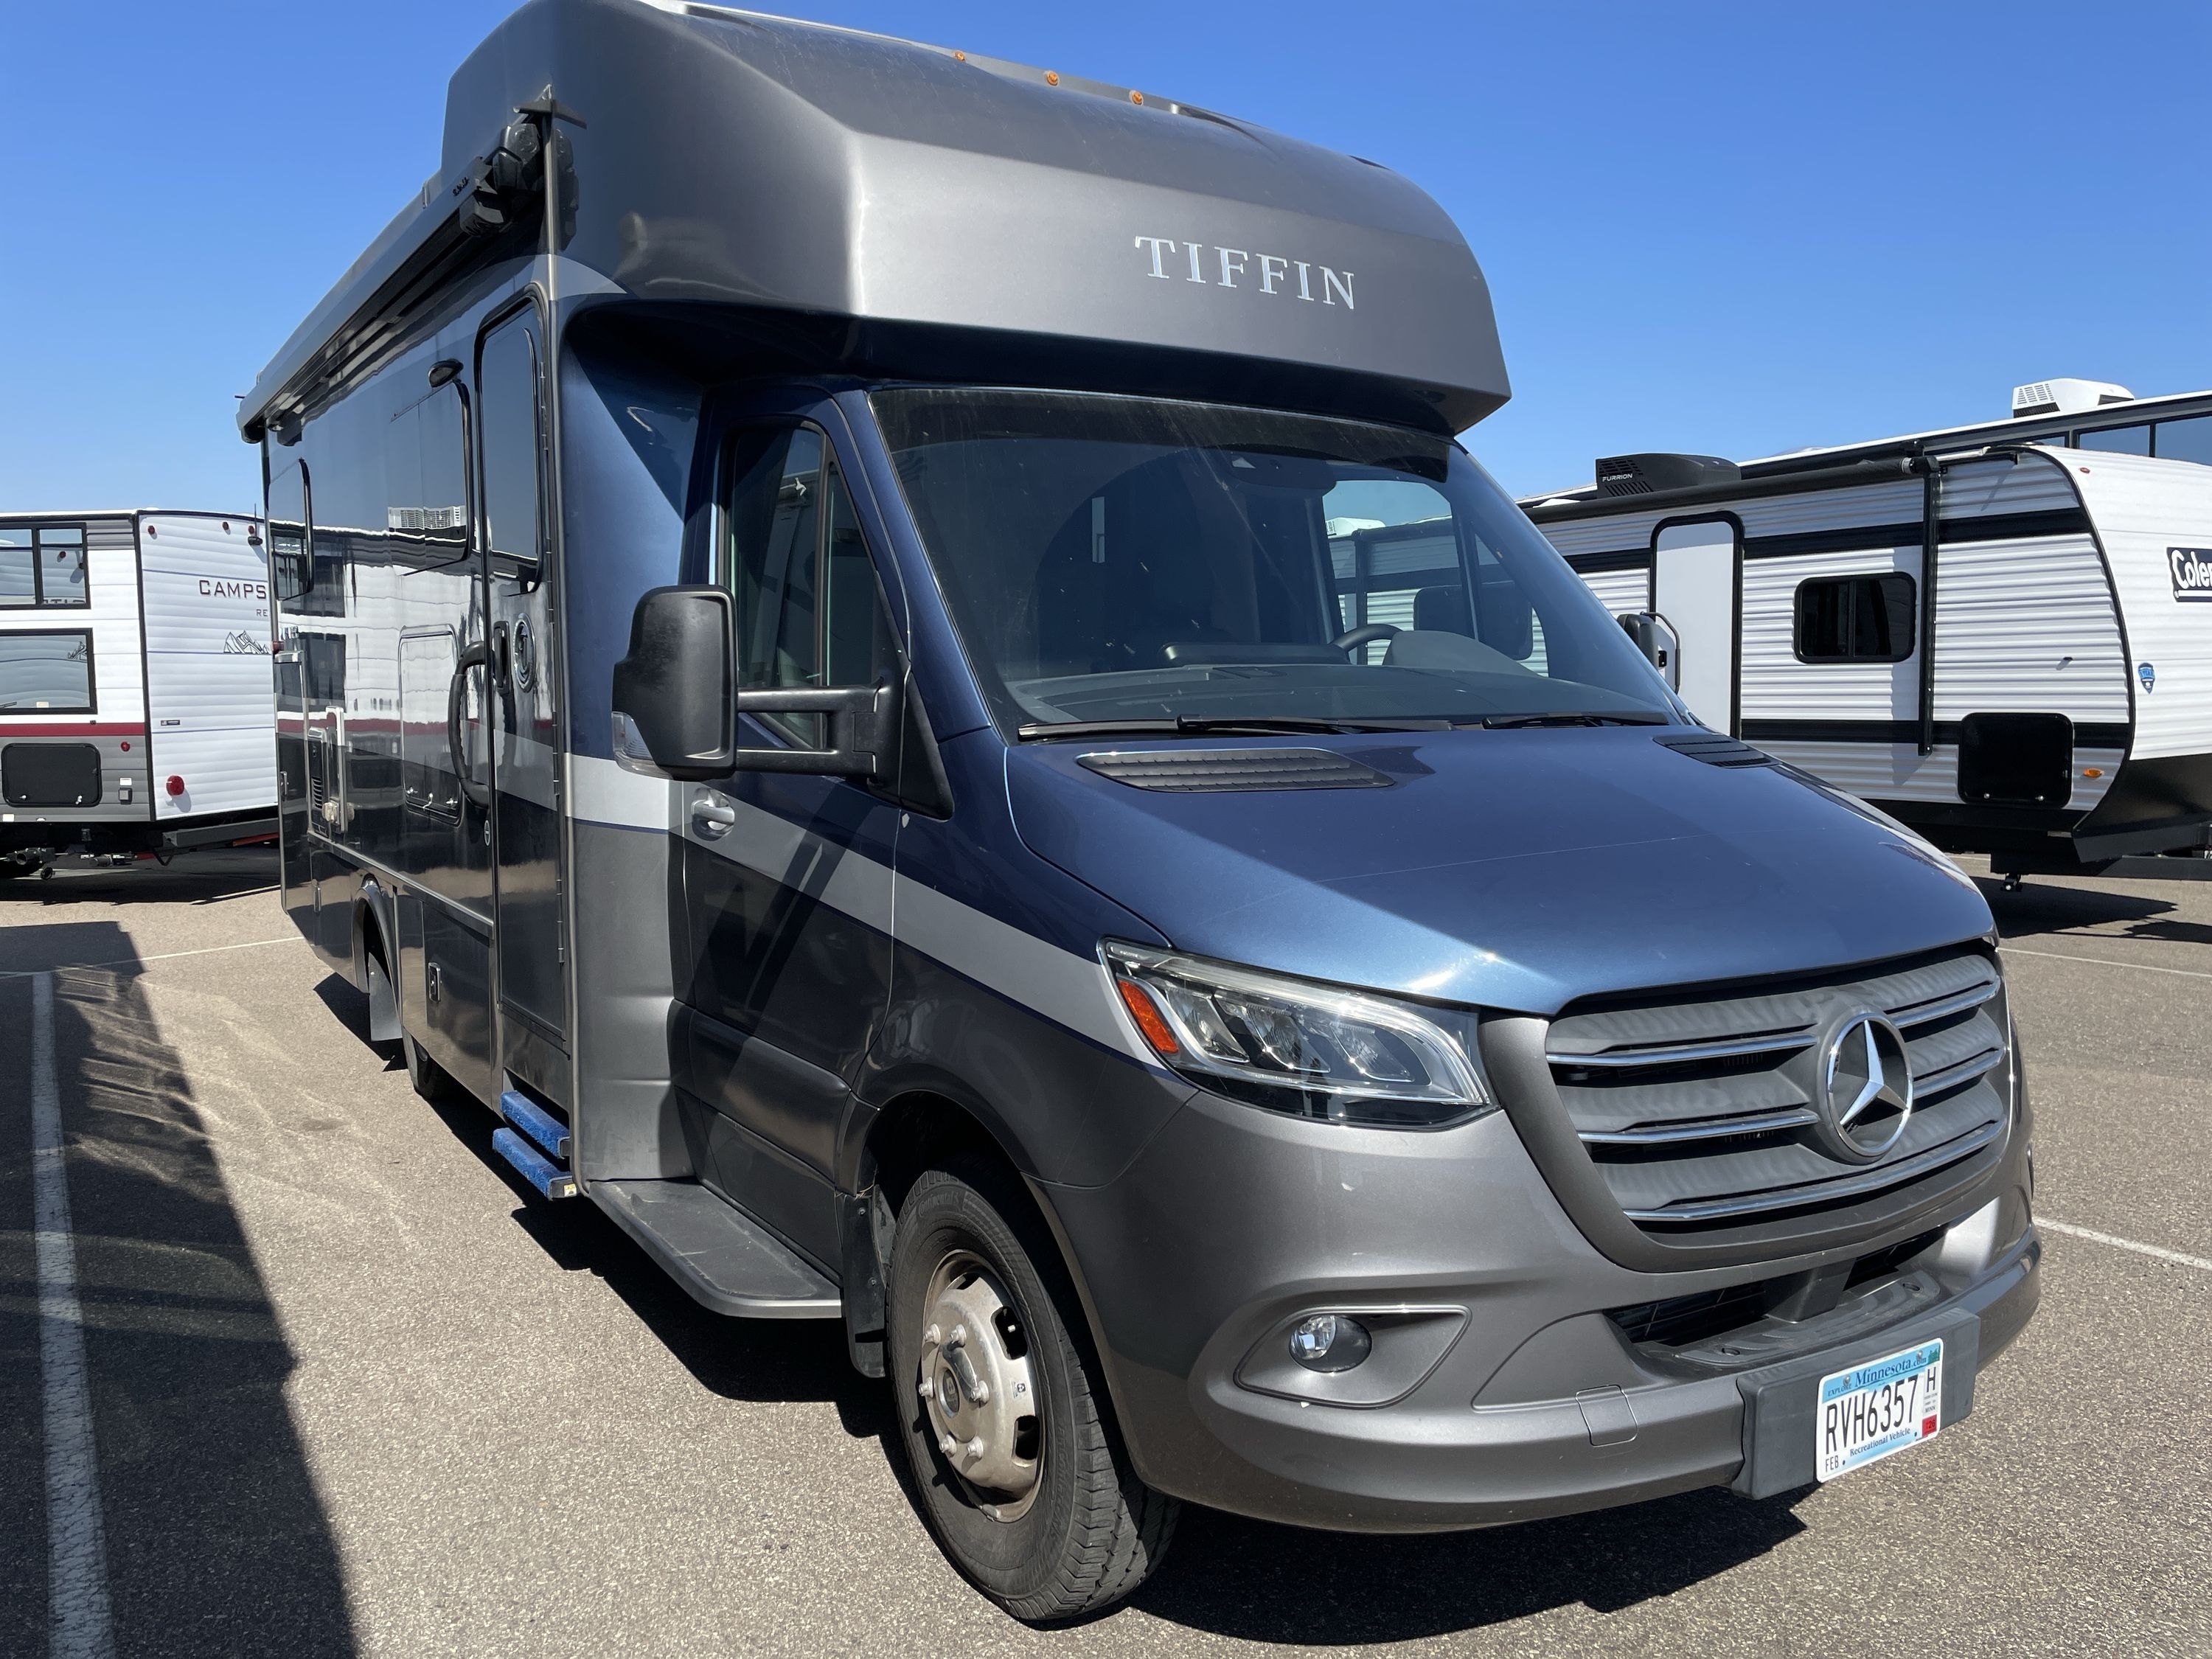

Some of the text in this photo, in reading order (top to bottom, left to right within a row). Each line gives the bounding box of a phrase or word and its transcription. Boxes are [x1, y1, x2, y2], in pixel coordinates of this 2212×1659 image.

[1134, 235, 1354, 310] TIFFIN
[1601, 473, 1633, 482] FURRION
[2171, 549, 2212, 590] Cole
[1926, 1366, 1937, 1393] H
[1826, 1374, 1919, 1455] RVH6357
[1928, 1419, 1935, 1429] 26
[1849, 1427, 1911, 1457] Recreational Vehicle
[1825, 1454, 1840, 1473] FEB
